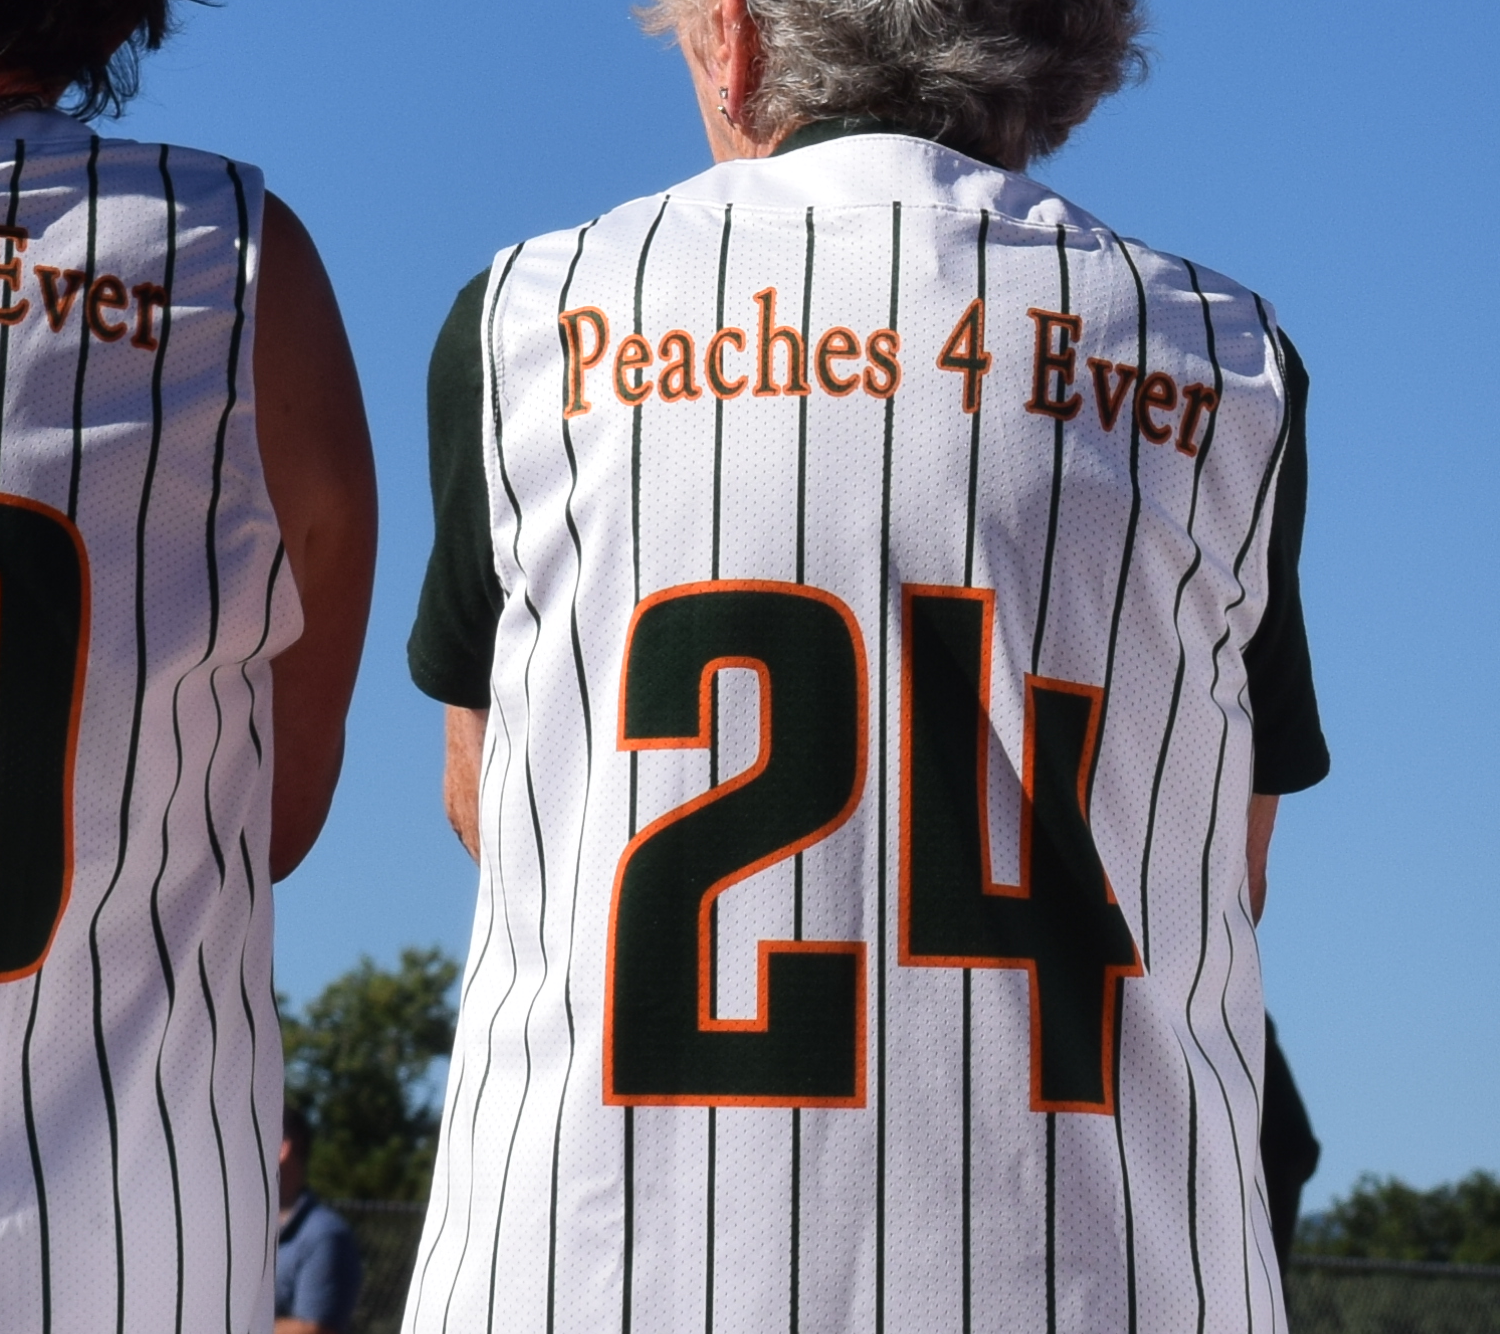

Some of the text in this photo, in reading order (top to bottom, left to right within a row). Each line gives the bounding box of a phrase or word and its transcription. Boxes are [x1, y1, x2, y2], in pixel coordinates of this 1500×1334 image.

[558, 287, 1222, 459] Peaches 4 Ever
[602, 578, 1145, 1116] 24
